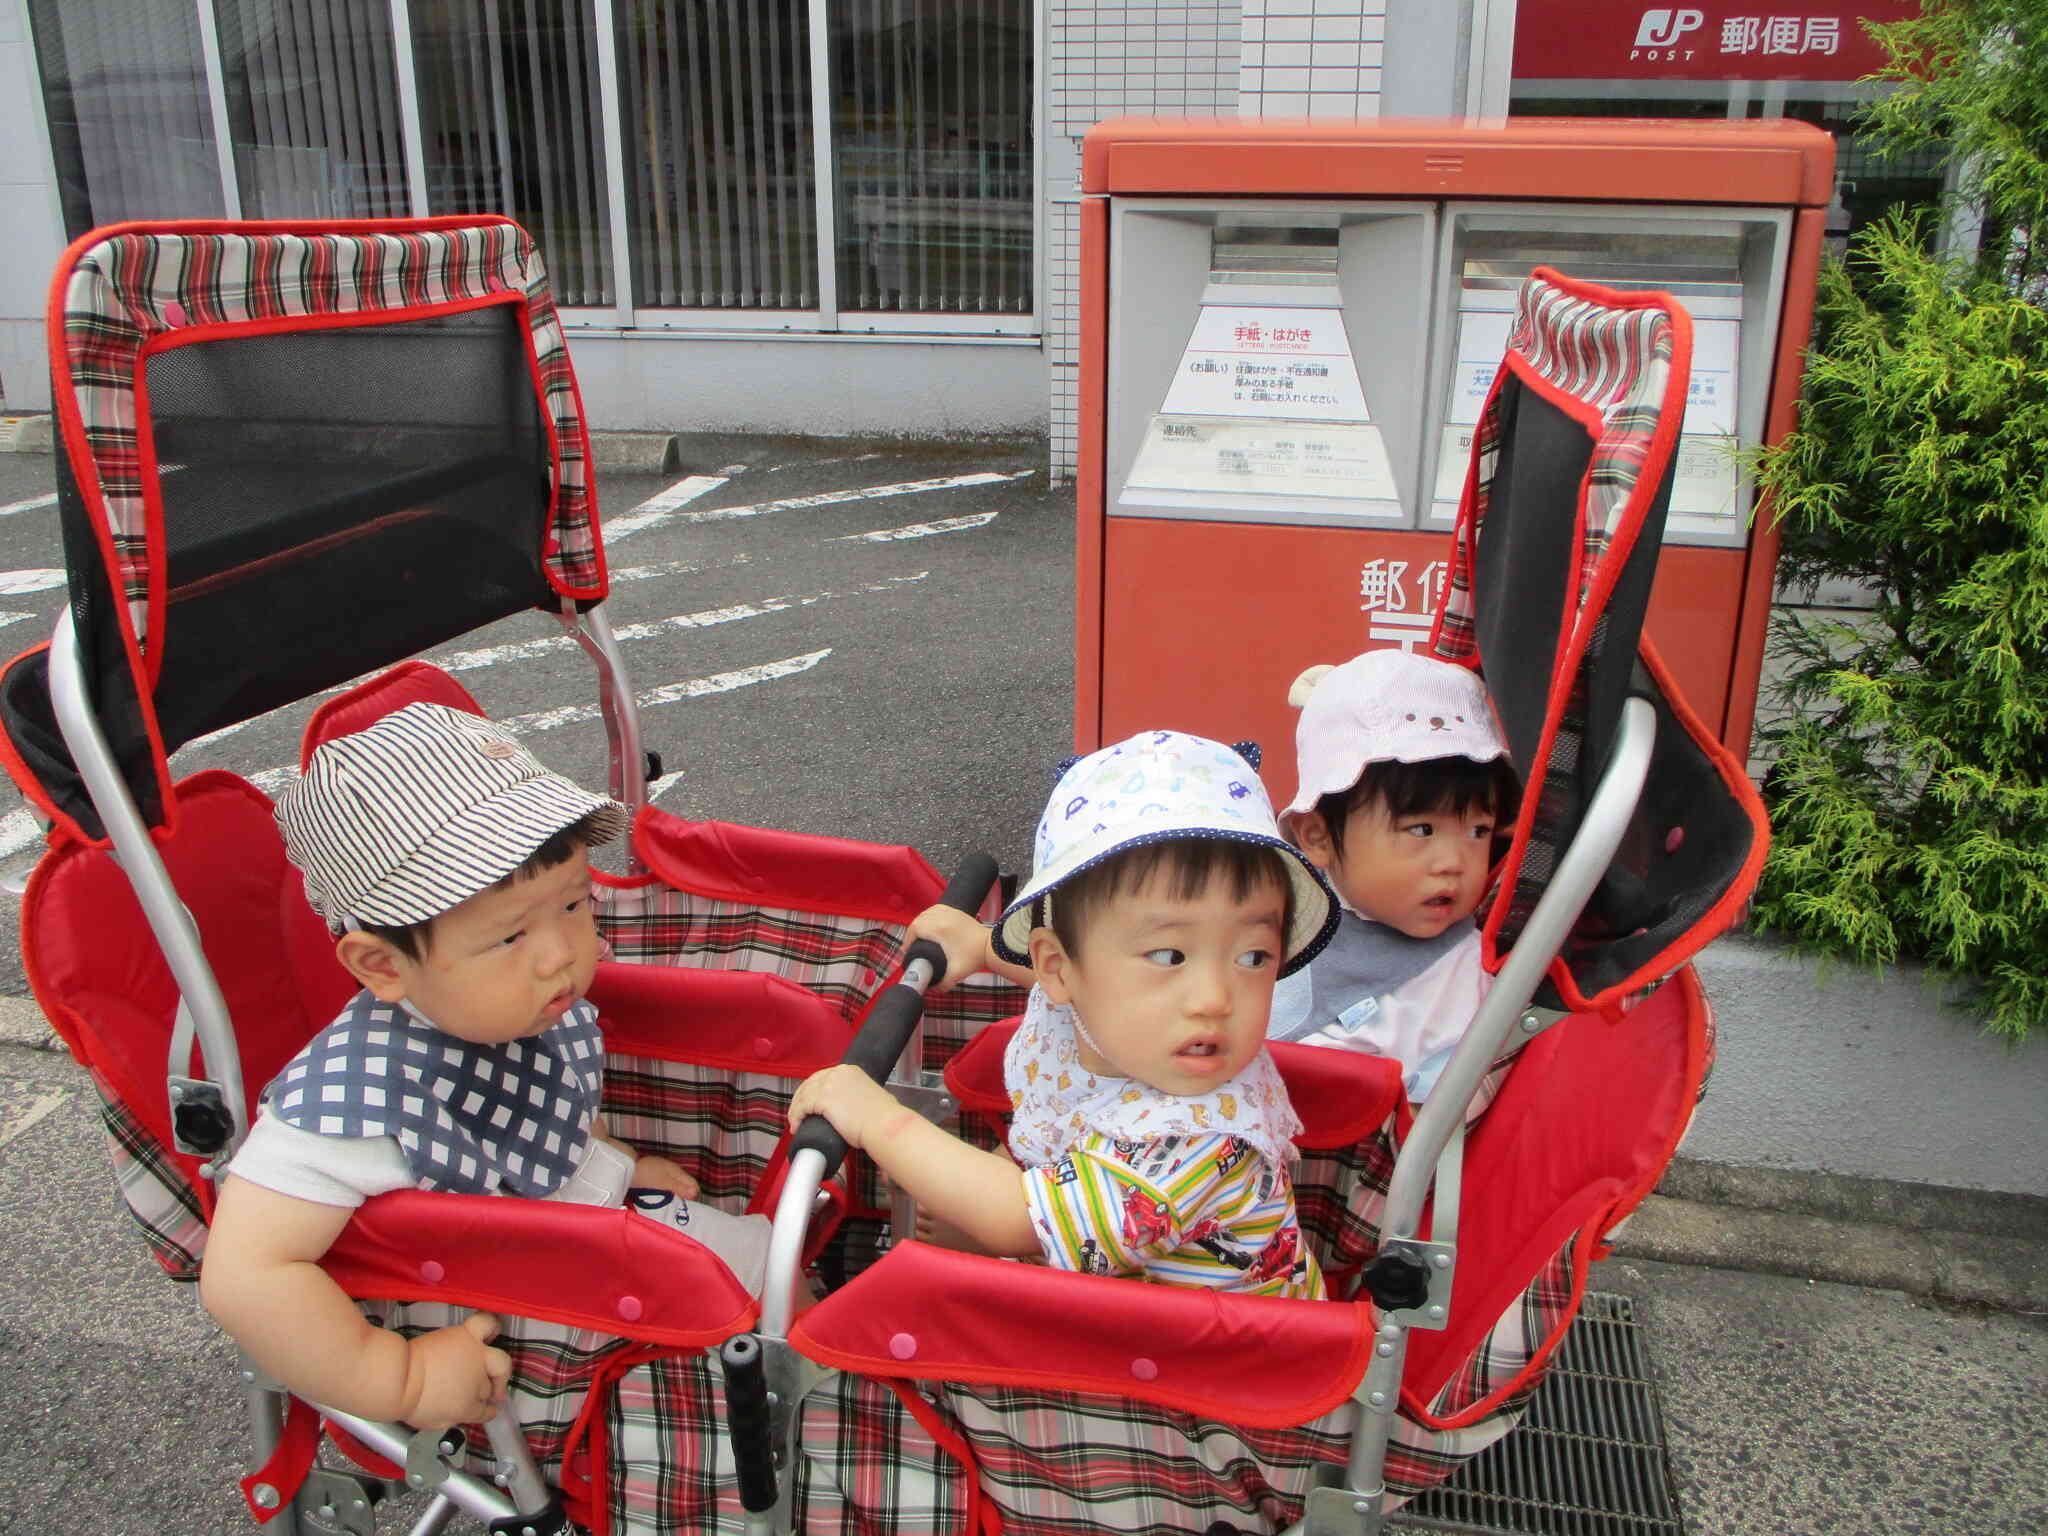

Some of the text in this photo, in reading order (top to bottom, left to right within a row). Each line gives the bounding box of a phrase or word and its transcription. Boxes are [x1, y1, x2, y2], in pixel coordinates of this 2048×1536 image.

[1719, 16, 1840, 55] 郵便局
[1630, 50, 1694, 61] POST
[1234, 327, 1312, 342] 手紙・はがき
